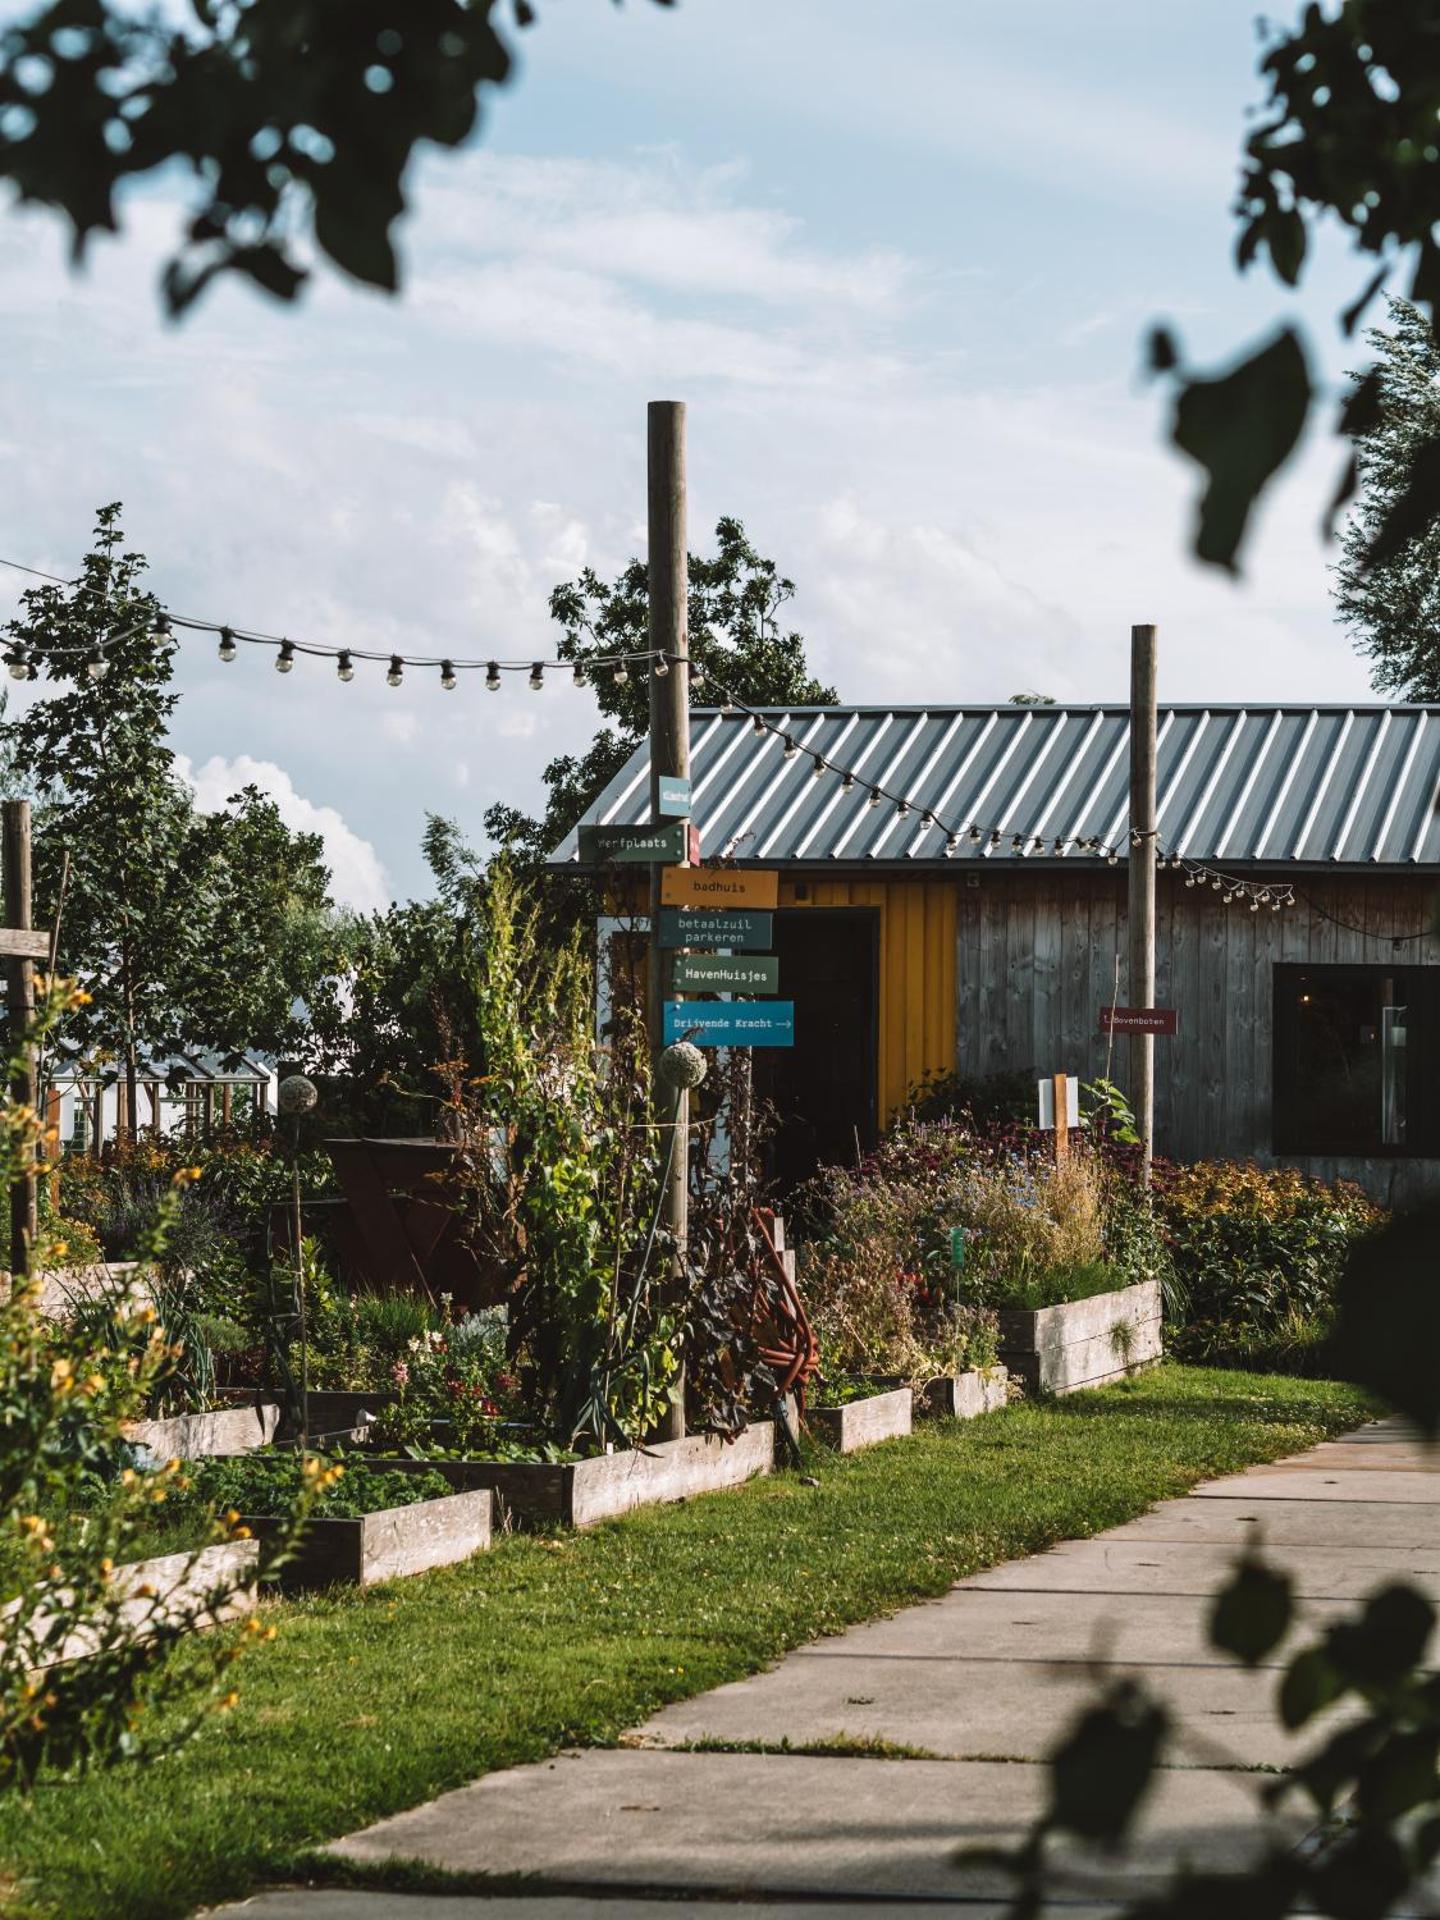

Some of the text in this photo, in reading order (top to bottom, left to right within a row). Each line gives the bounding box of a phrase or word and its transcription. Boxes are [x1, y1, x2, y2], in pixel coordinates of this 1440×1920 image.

[693, 881, 746, 893] badhuis
[678, 919, 752, 930] betaalzuil
[685, 931, 744, 943] parkeren
[685, 968, 767, 982] HavenHuisjes
[735, 1018, 772, 1028] Kracht
